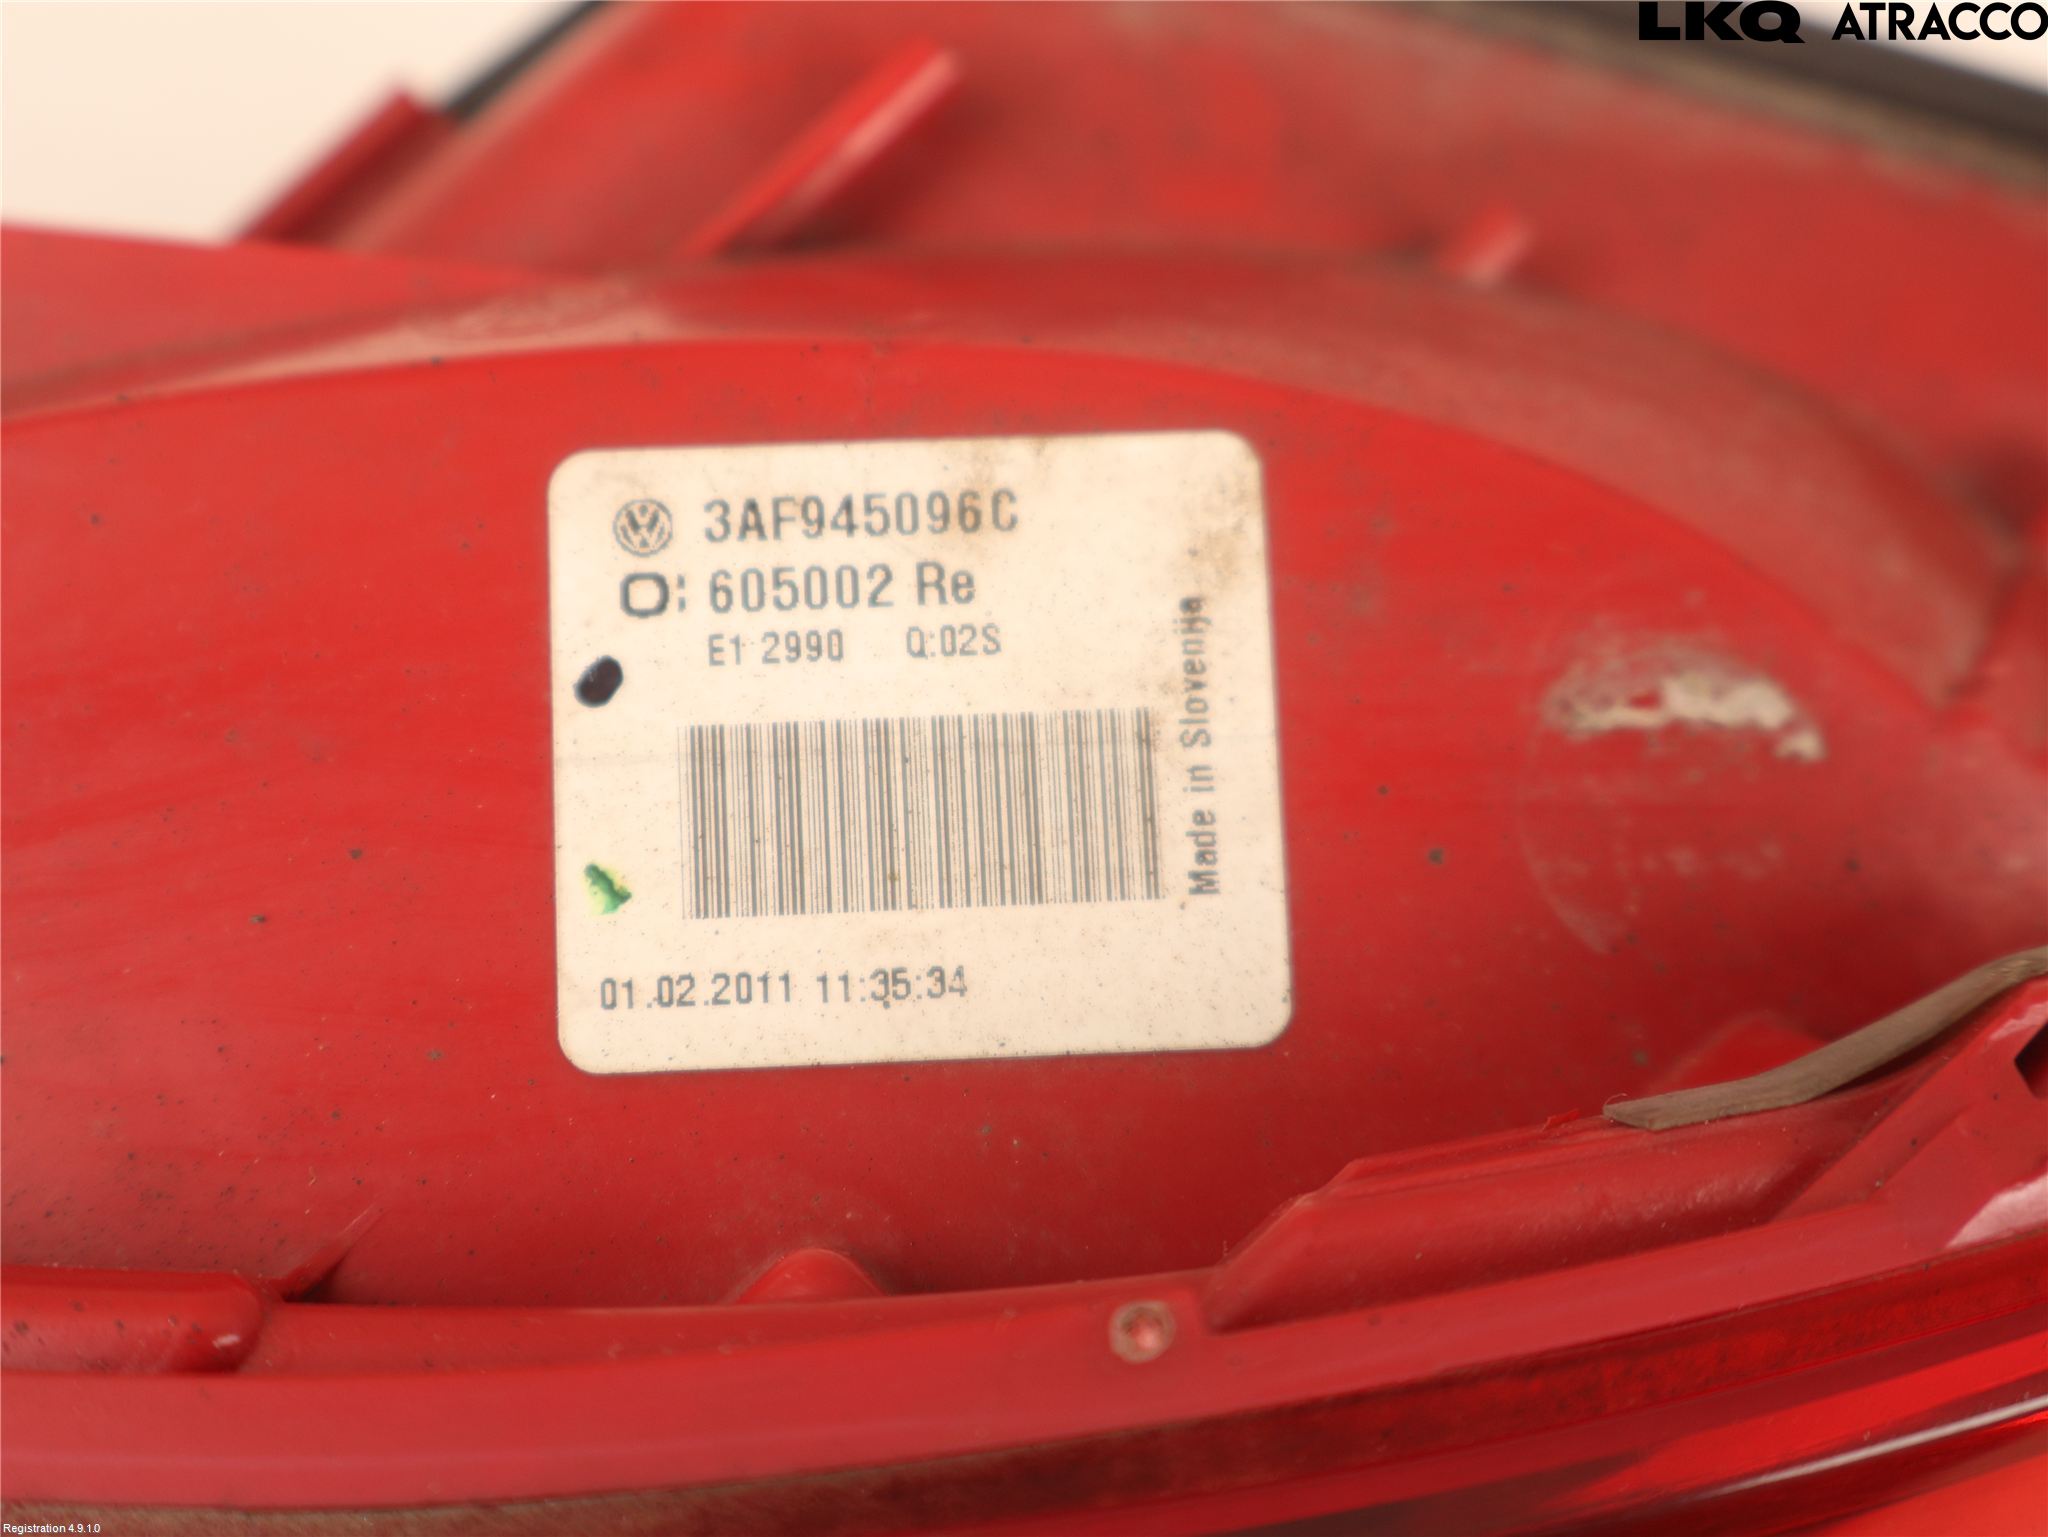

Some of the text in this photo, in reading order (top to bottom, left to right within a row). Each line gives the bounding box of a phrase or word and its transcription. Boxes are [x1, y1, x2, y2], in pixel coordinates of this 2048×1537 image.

[703, 488, 1018, 543] 3AF945096C
[708, 563, 894, 614] 605002
[915, 560, 976, 606] Re
[707, 633, 743, 666] E1
[761, 629, 845, 665] 2990
[1172, 596, 1221, 896] Made in Slovenija
[599, 965, 968, 1009] 01.02.2011 11:35:34
